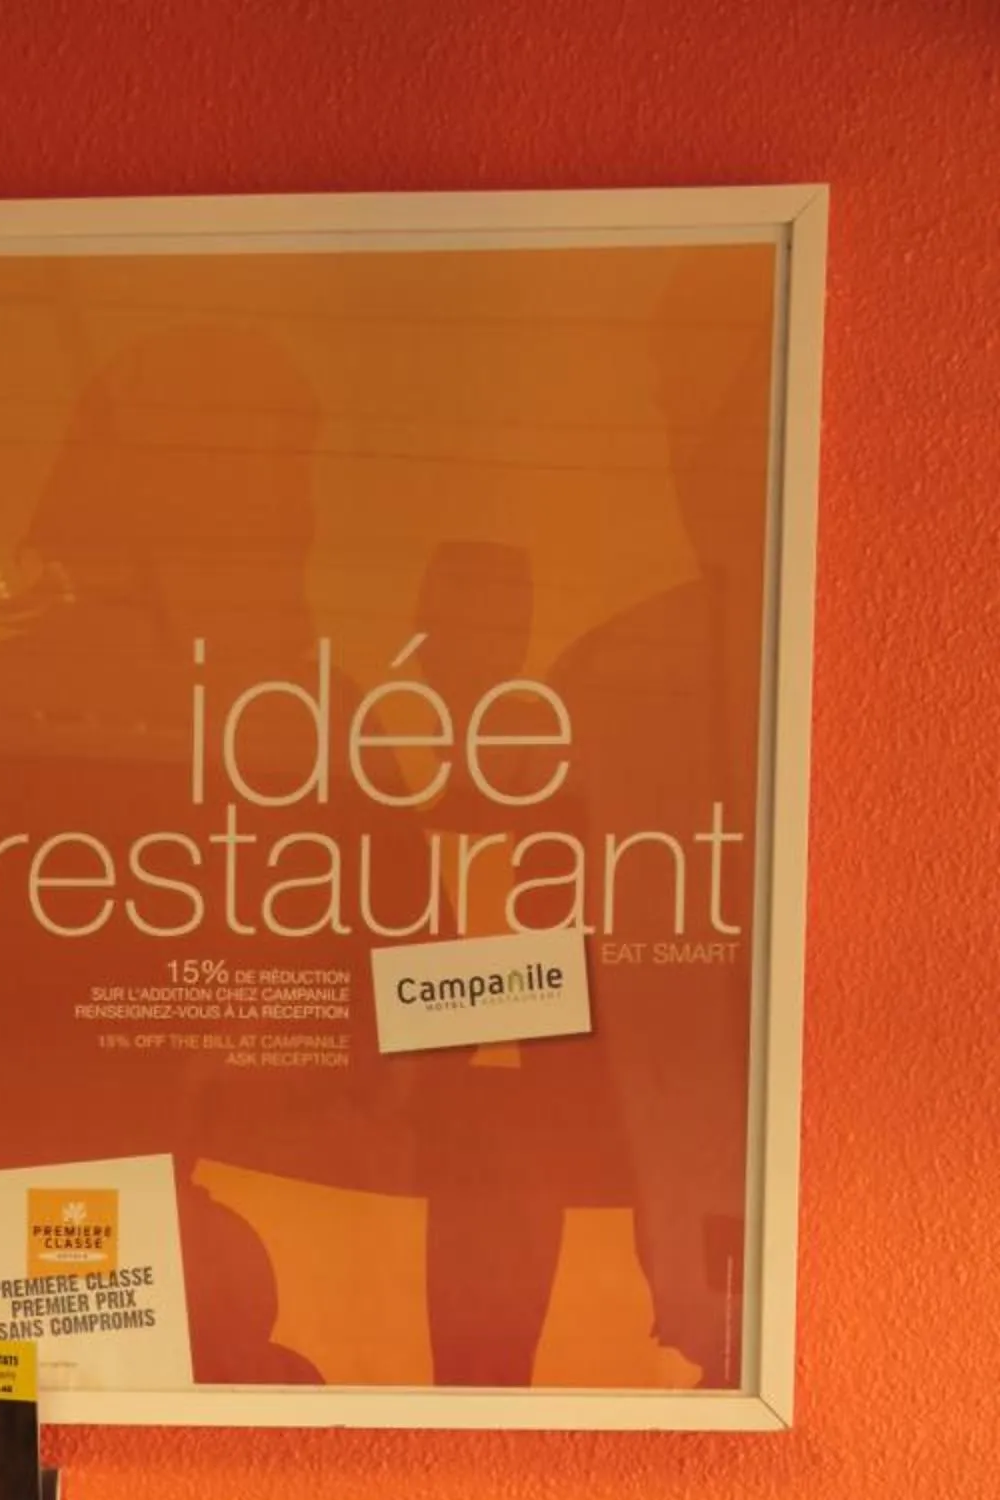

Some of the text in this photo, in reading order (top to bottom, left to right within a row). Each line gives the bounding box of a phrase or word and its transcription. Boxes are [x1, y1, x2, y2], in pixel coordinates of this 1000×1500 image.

[192, 633, 573, 807] idée
[601, 942, 740, 964] EAT SMART
[167, 959, 229, 985] 15%
[235, 971, 256, 985] DE
[91, 987, 124, 1001] SUR
[216, 987, 254, 1001] CHEZ
[261, 987, 350, 1001] CAMPANILE
[397, 963, 564, 1006] Campanile
[239, 1005, 259, 1019] LA
[134, 1034, 165, 1049] OFF
[170, 1034, 199, 1049] THE
[203, 1034, 235, 1049] BILL
[239, 1034, 257, 1049] AT
[261, 1034, 350, 1049] CAMPANILE
[225, 1052, 349, 1067] ASK RECEPTION
[44, 1238, 103, 1249] CLASSE
[85, 1266, 154, 1292] CLASSE
[11, 1289, 137, 1318] PREMIER PRIX
[50, 1309, 157, 1337] COMPROMIS
